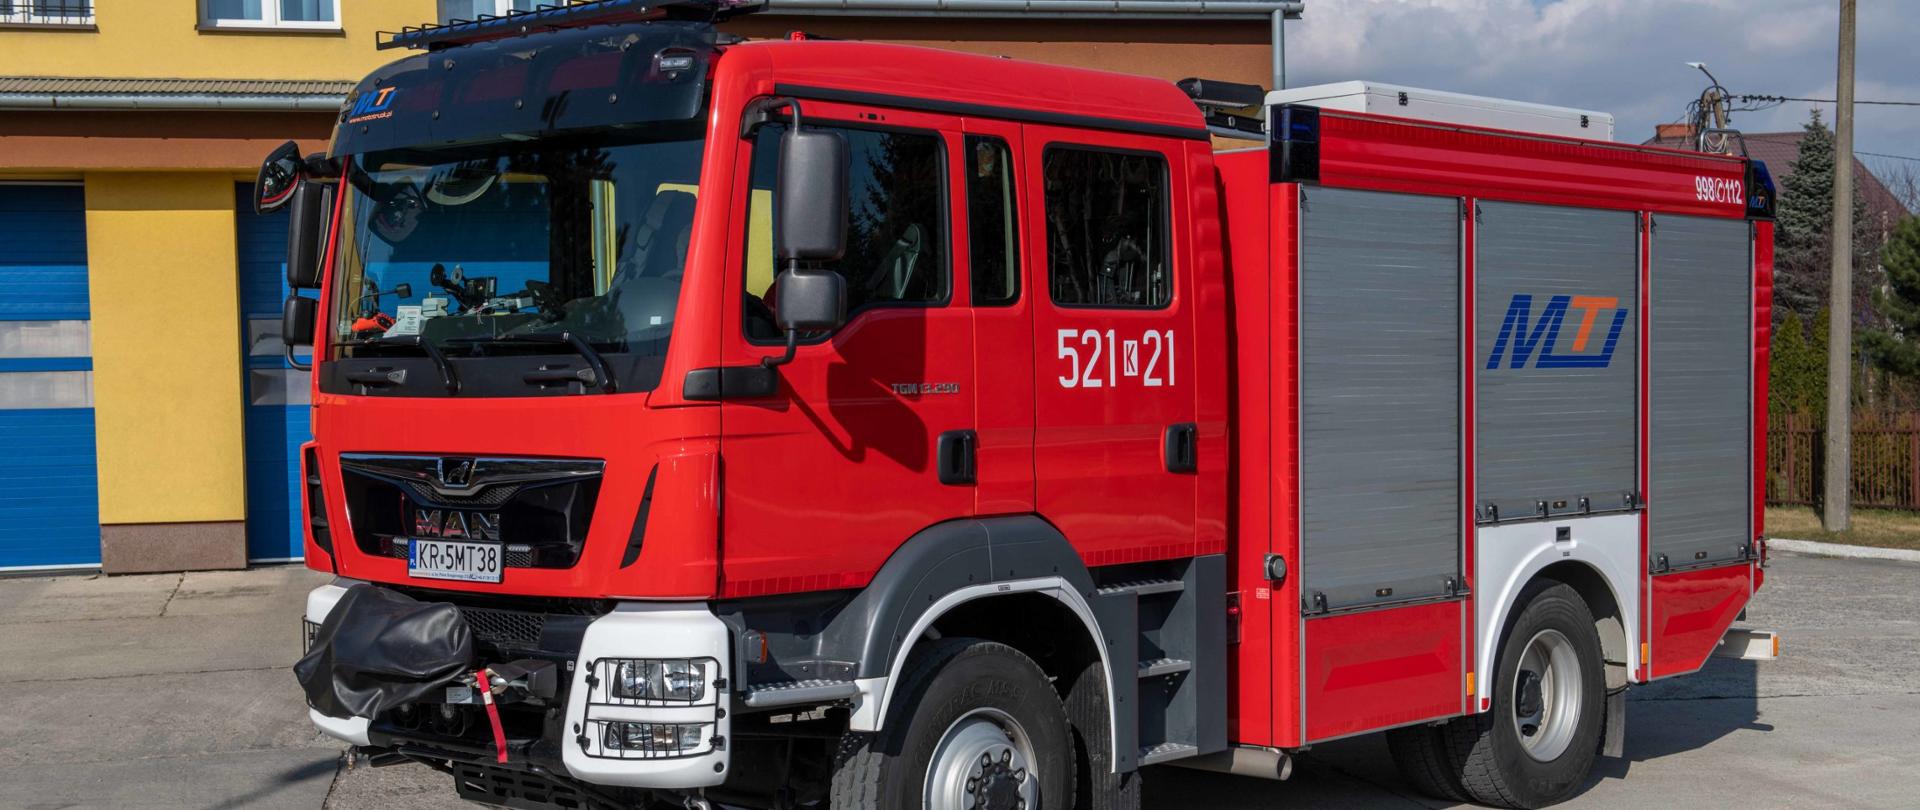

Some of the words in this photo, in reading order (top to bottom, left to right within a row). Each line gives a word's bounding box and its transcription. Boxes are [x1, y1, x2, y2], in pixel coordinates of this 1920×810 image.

[1695, 175, 1715, 202] 998
[1725, 179, 1743, 204] 112
[1057, 328, 1116, 388] 521
[1125, 342, 1137, 374] K
[1142, 329, 1175, 387] 21
[892, 383, 918, 395] TGM
[919, 383, 960, 394] 13.290
[415, 510, 500, 540] MAN
[419, 543, 439, 569] KR
[445, 544, 497, 573] 5MT38
